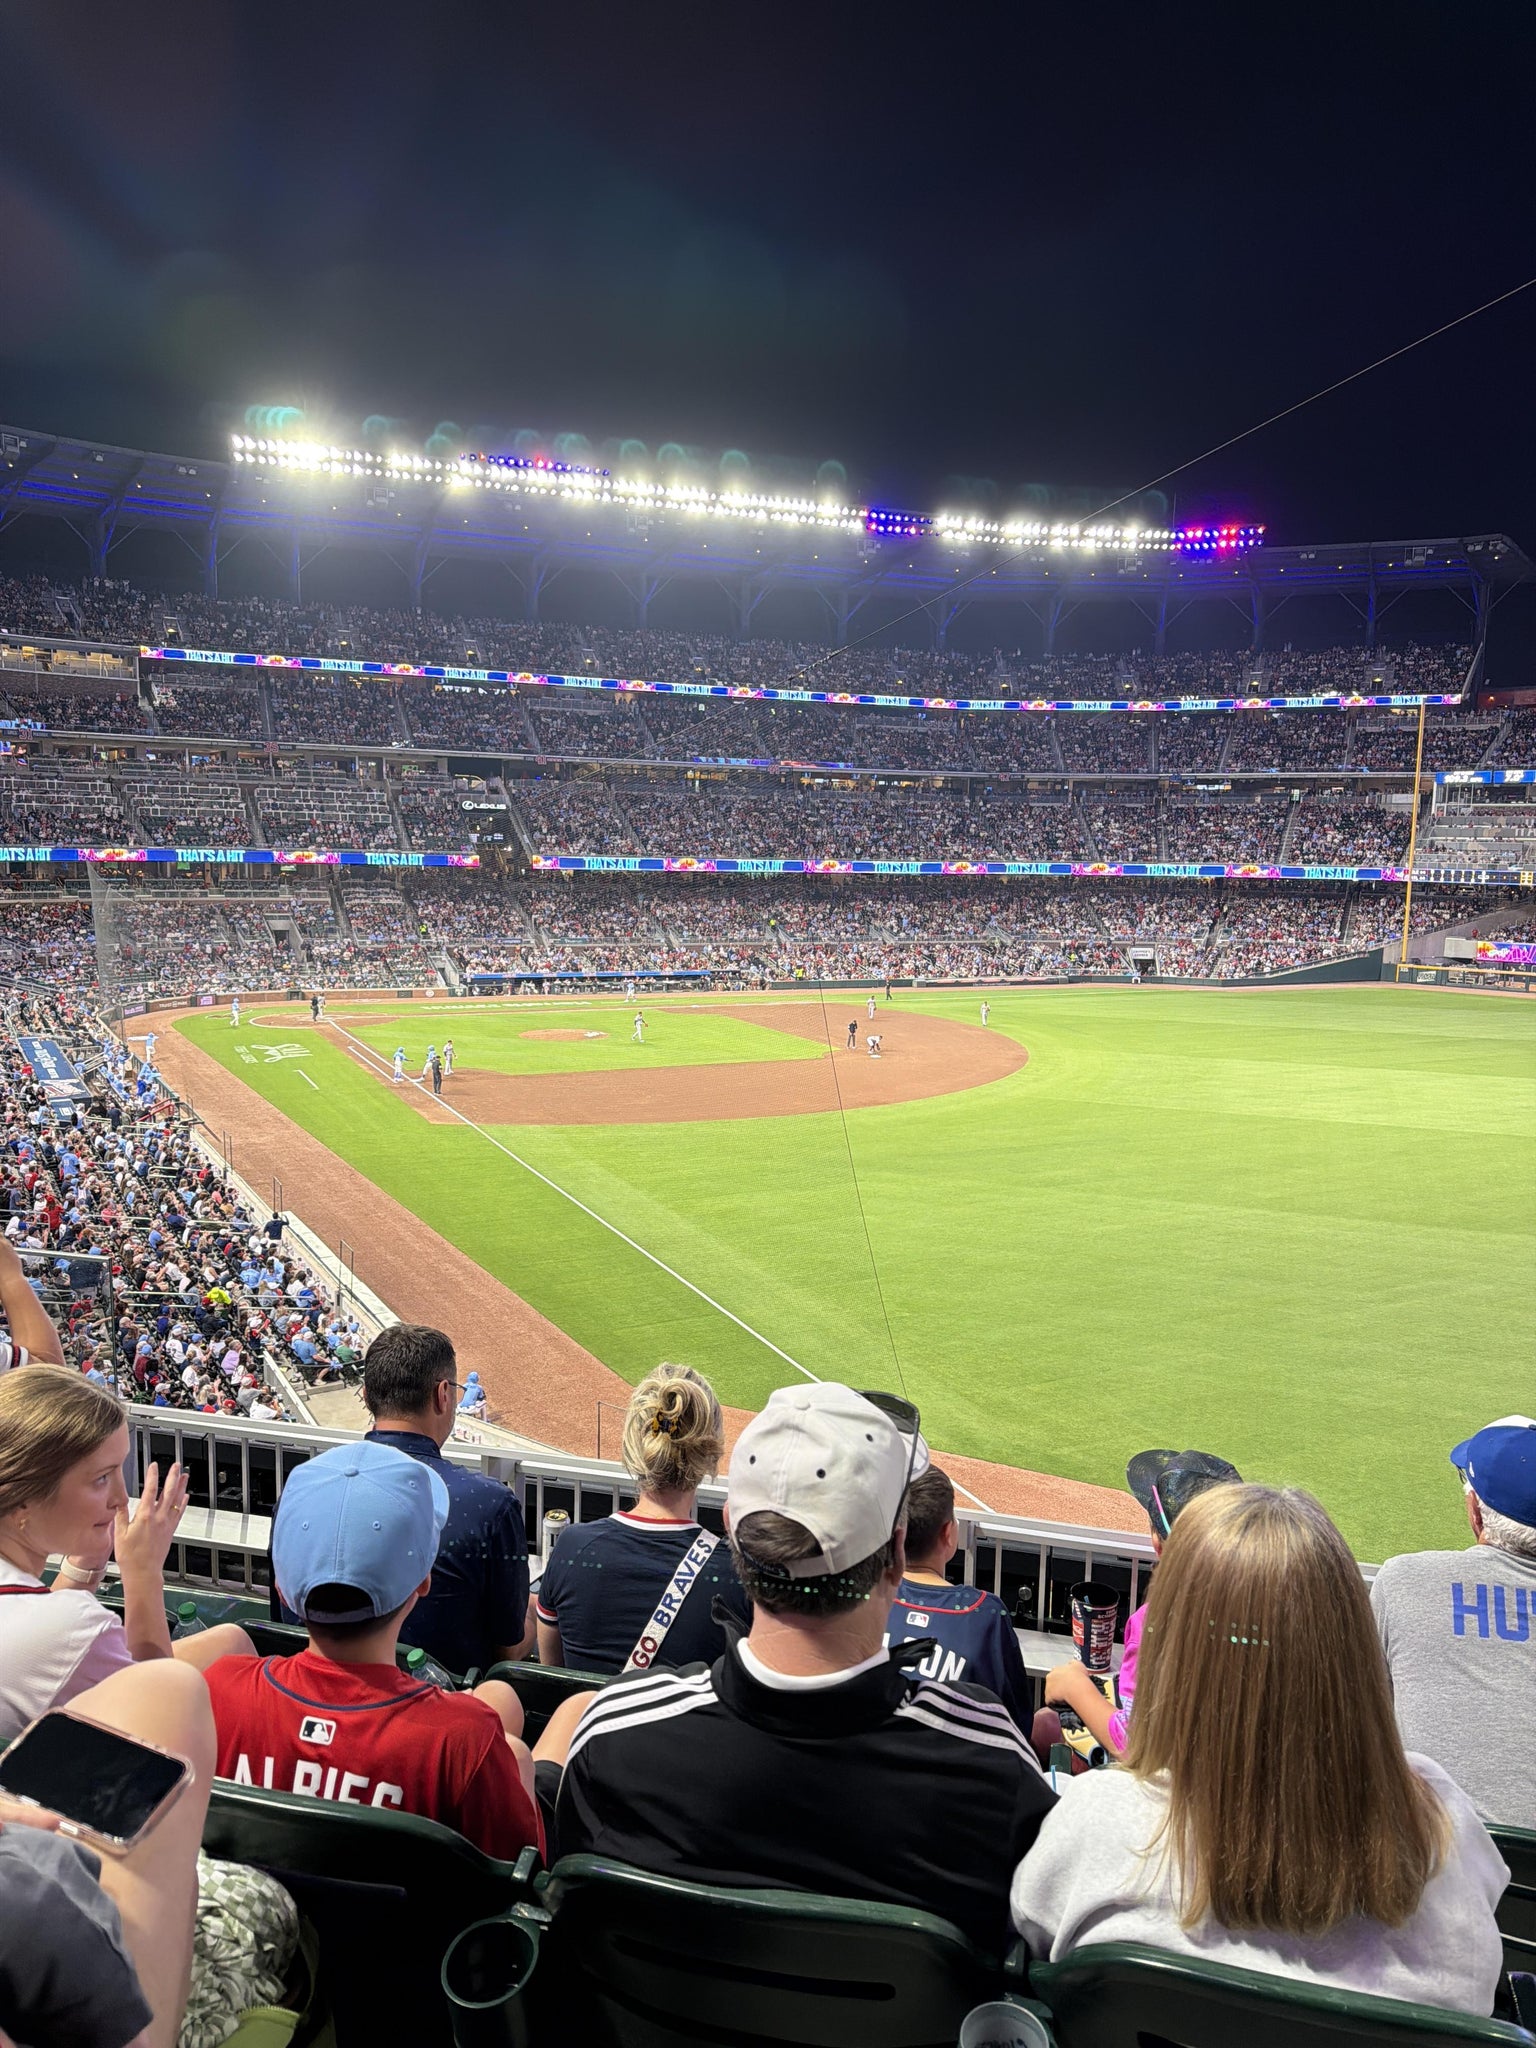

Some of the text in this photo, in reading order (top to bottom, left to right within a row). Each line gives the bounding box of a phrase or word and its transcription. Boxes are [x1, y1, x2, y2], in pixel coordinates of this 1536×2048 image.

[26, 848, 35, 862] A
[35, 848, 52, 862] HIT
[216, 850, 225, 862] A
[226, 850, 245, 862] HIT
[400, 853, 408, 865] A
[408, 854, 424, 866] HIT
[617, 858, 625, 870] A
[626, 858, 640, 870] HIT
[632, 1539, 712, 1668] GO BRAVES
[1452, 1582, 1536, 1642] HU
